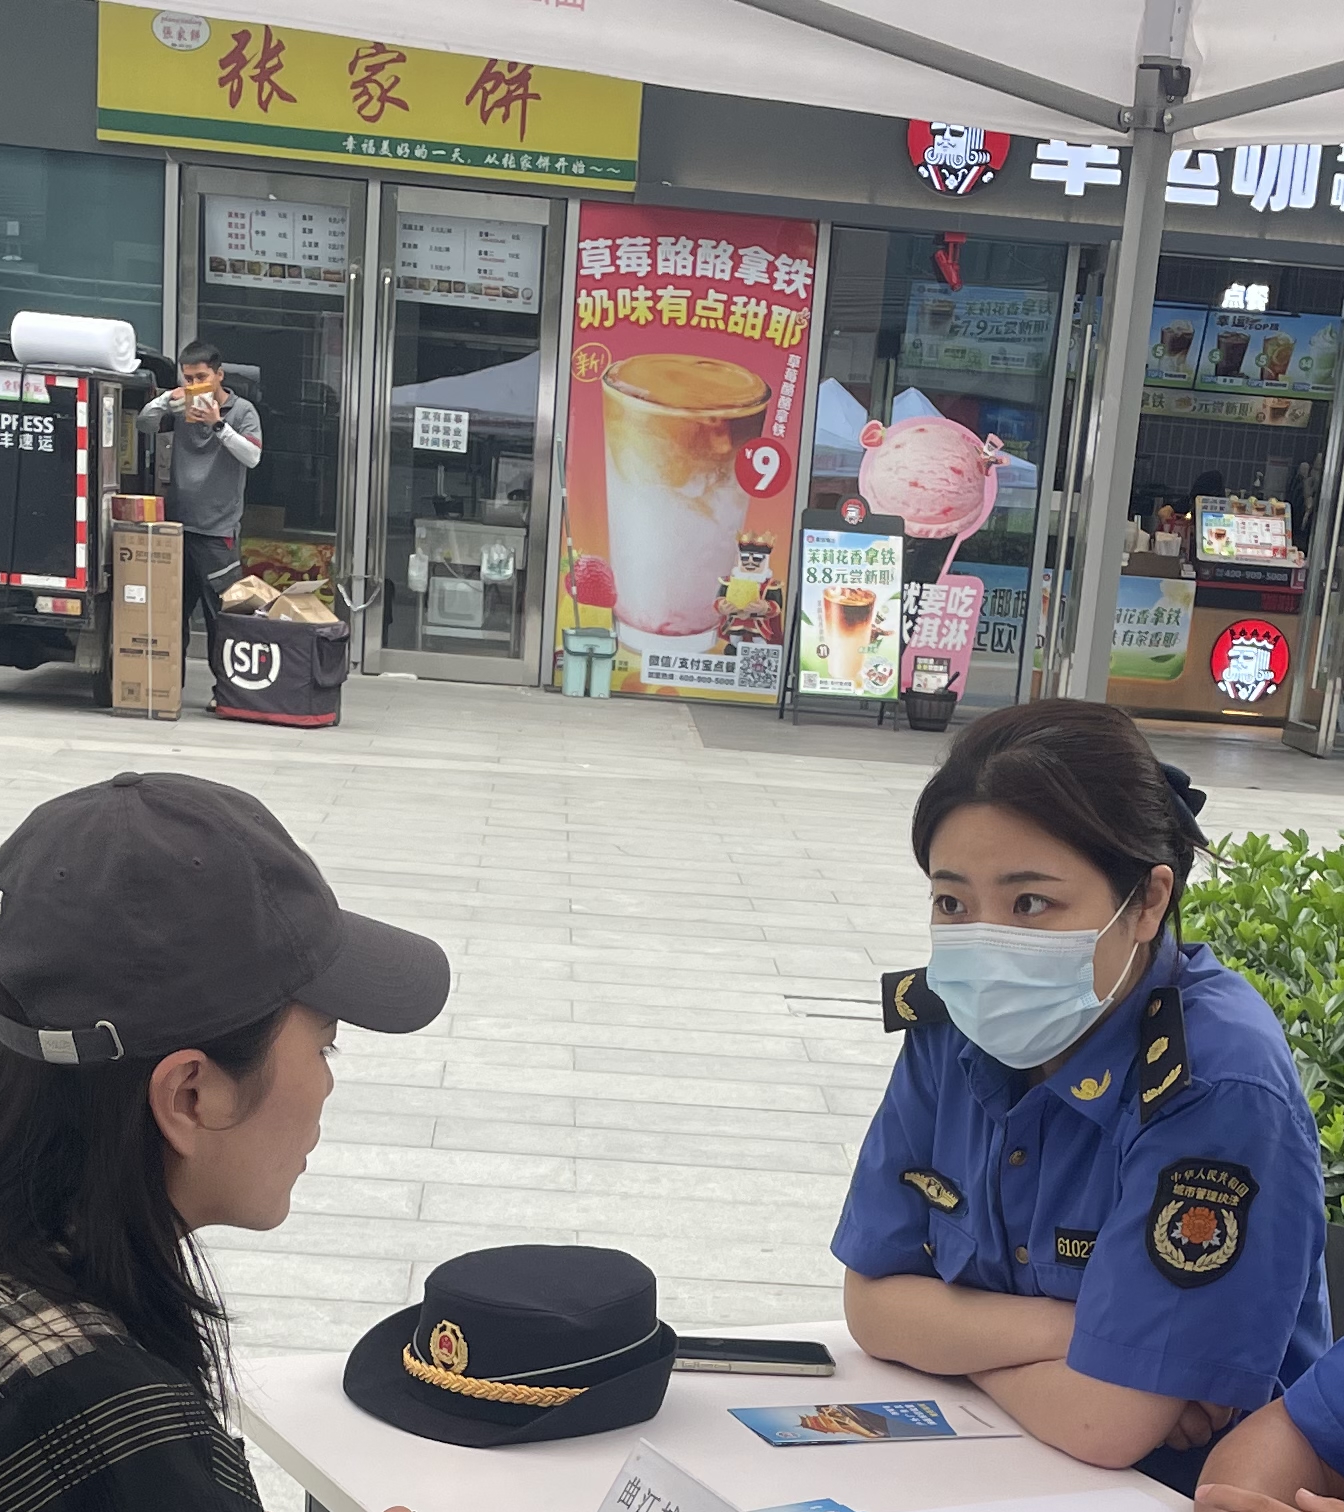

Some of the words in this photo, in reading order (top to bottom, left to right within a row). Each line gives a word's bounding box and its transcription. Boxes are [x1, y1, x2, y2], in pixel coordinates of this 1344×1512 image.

[218, 24, 542, 142] 张家饼
[578, 236, 813, 299] 草莓酪酪拿铁
[577, 285, 810, 348] 奶味有点甜耶
[772, 354, 802, 437] 草莓酪酪拿铁
[419, 437, 463, 450] 时间待定
[421, 424, 463, 437] 暂停营业
[807, 548, 896, 565] 茉莉花香拿铁
[1170, 1168, 1249, 1197] 中华人民共和国
[1172, 1183, 1239, 1206] 城市管理执法
